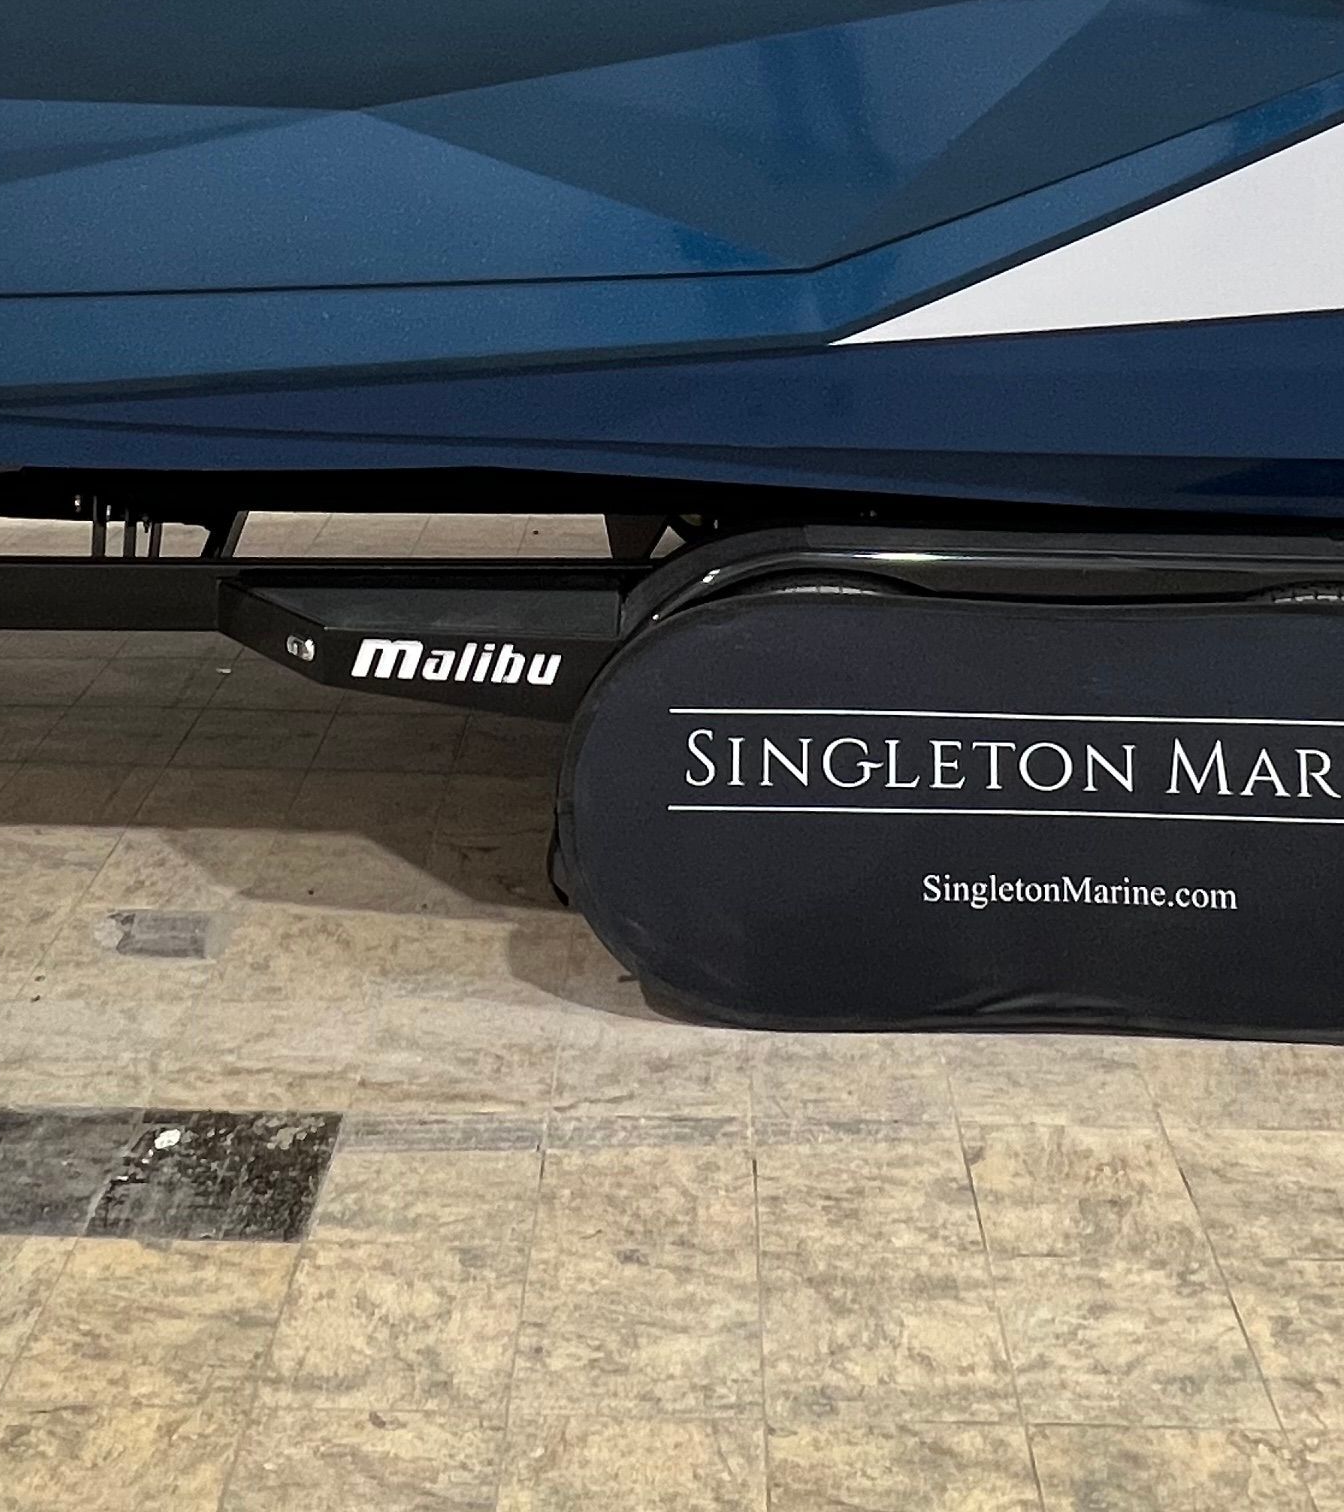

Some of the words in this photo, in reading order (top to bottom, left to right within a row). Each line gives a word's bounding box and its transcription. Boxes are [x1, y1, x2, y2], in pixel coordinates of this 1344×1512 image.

[351, 638, 562, 686] Malibu
[685, 728, 1137, 793] SINGLETON
[922, 873, 1239, 911] SingletonMarine.com
